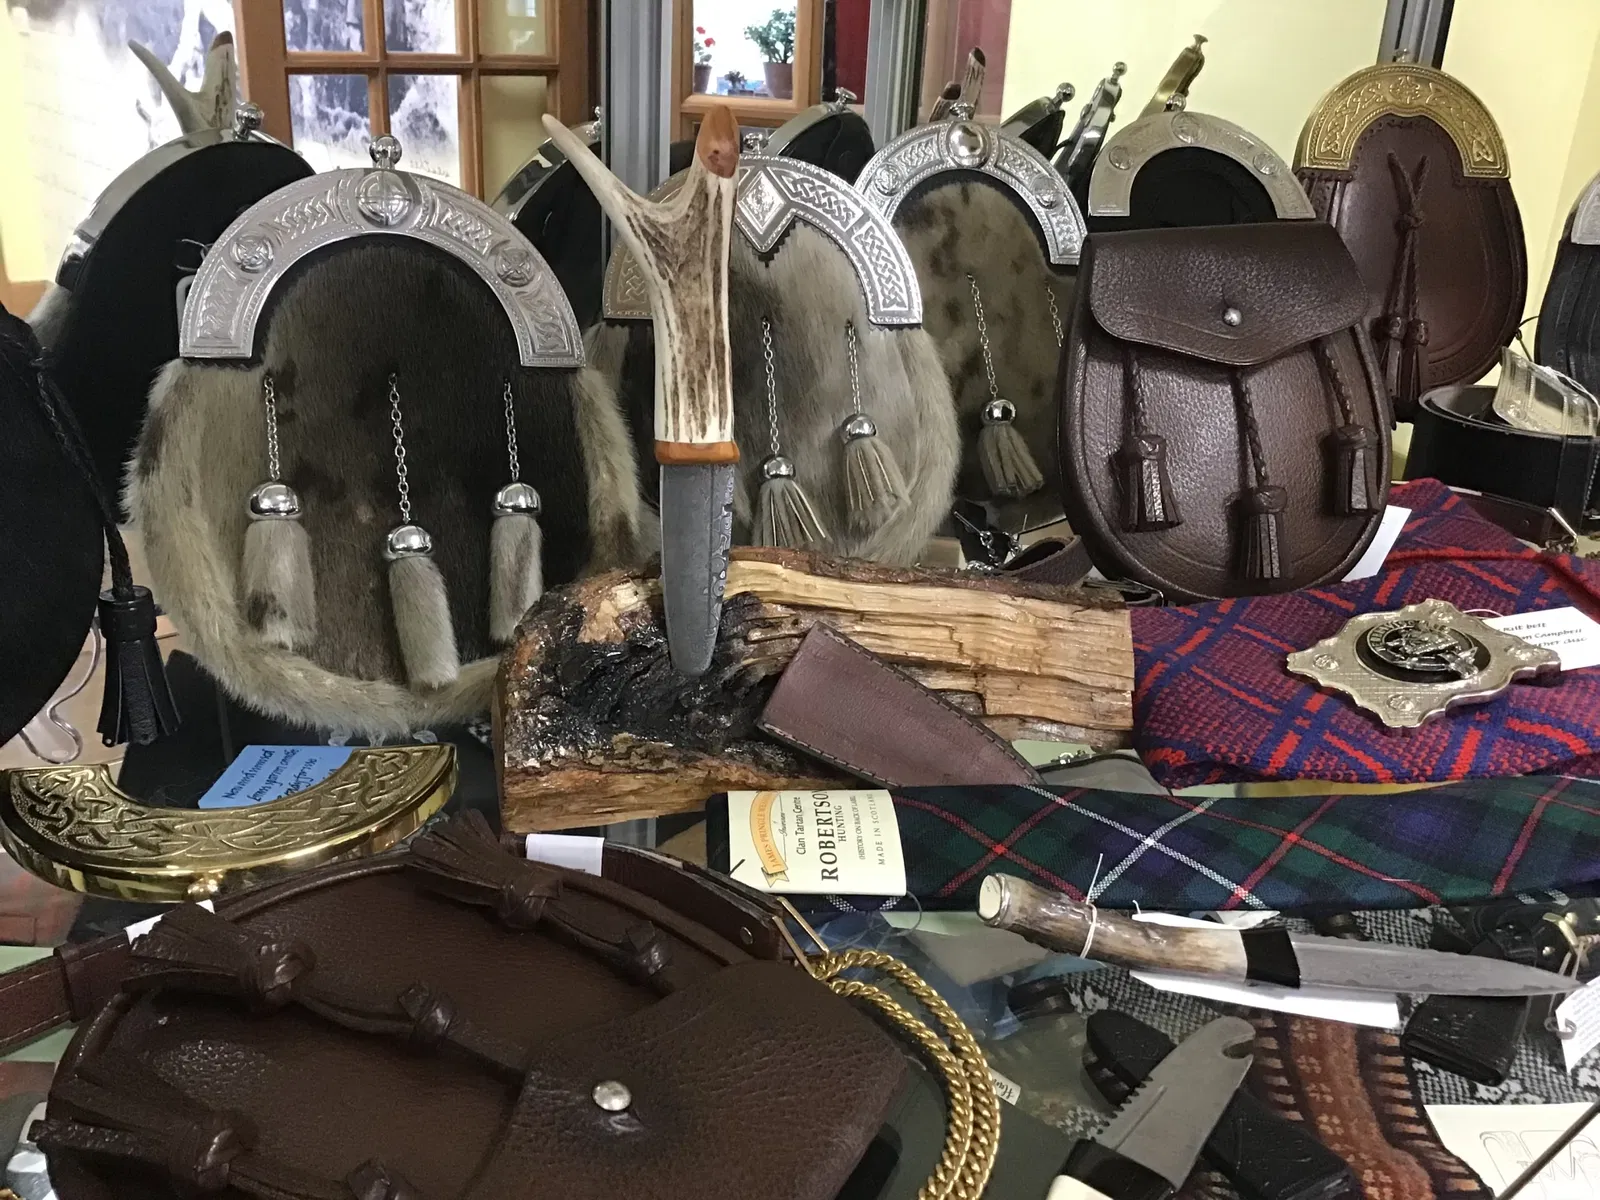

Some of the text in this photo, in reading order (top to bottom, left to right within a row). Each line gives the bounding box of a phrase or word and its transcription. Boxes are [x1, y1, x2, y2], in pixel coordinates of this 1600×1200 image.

[1534, 628, 1582, 639] Campbell
[756, 813, 769, 843] PRINGLE
[792, 796, 806, 855] Clan Tartan Centre
[833, 805, 847, 842] HUNTING
[873, 828, 882, 837] IN
[764, 844, 782, 868] JAMES
[874, 840, 886, 866] MADE
